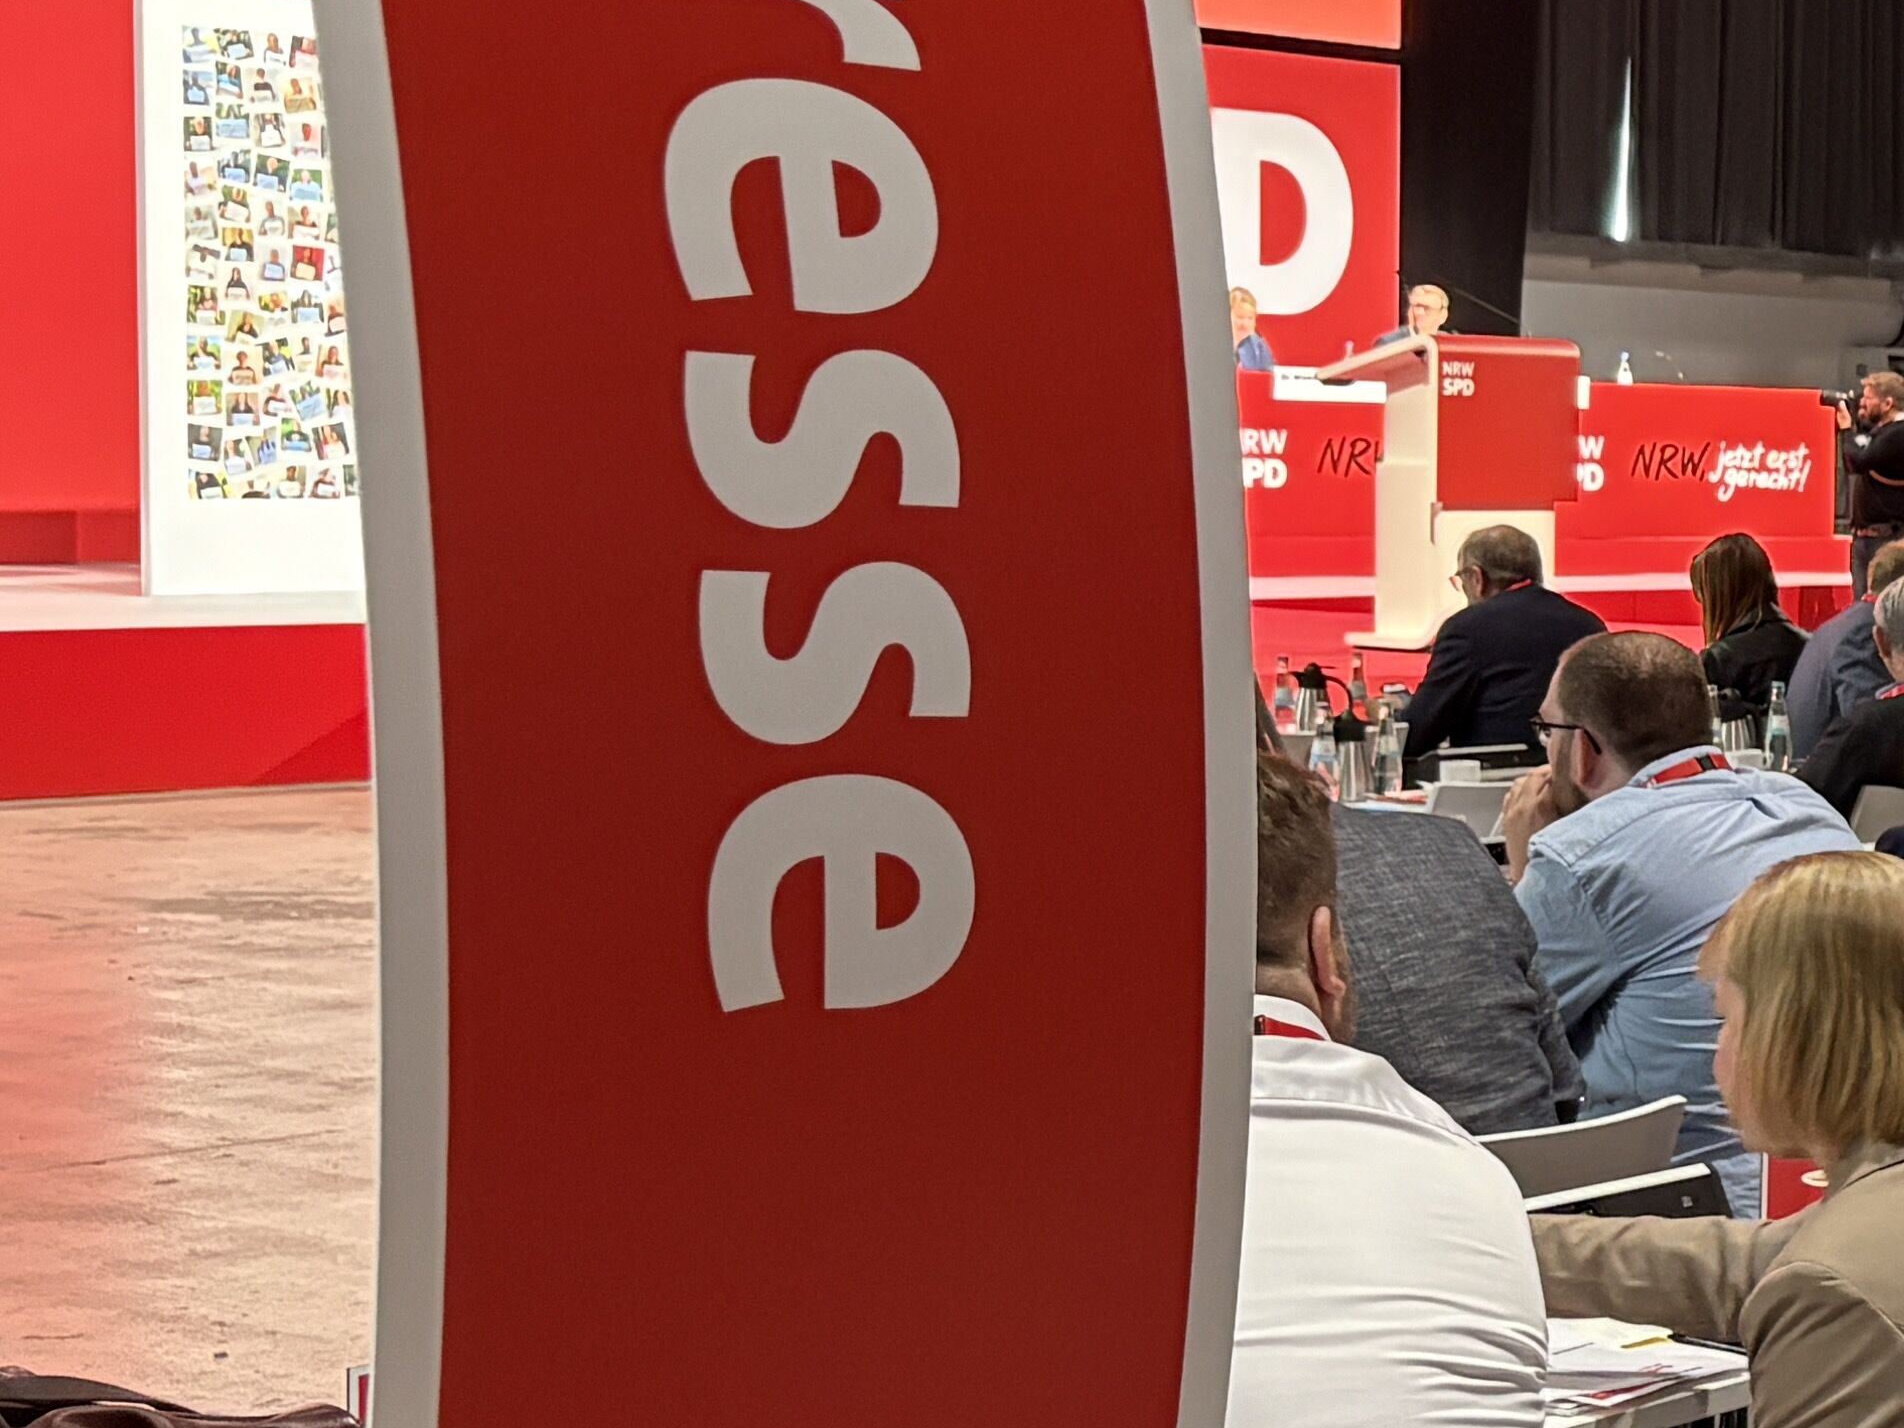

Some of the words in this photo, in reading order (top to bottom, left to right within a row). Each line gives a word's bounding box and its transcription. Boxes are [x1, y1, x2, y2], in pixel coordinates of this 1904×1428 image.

[1442, 360, 1476, 378] NRW
[1442, 379, 1476, 397] SPD
[1239, 427, 1288, 455] RW
[1316, 435, 1382, 479] NR
[1241, 457, 1288, 489] PD
[1708, 440, 1766, 484] jetzt
[1766, 441, 1810, 470] erst
[1717, 458, 1812, 503] gerecht!
